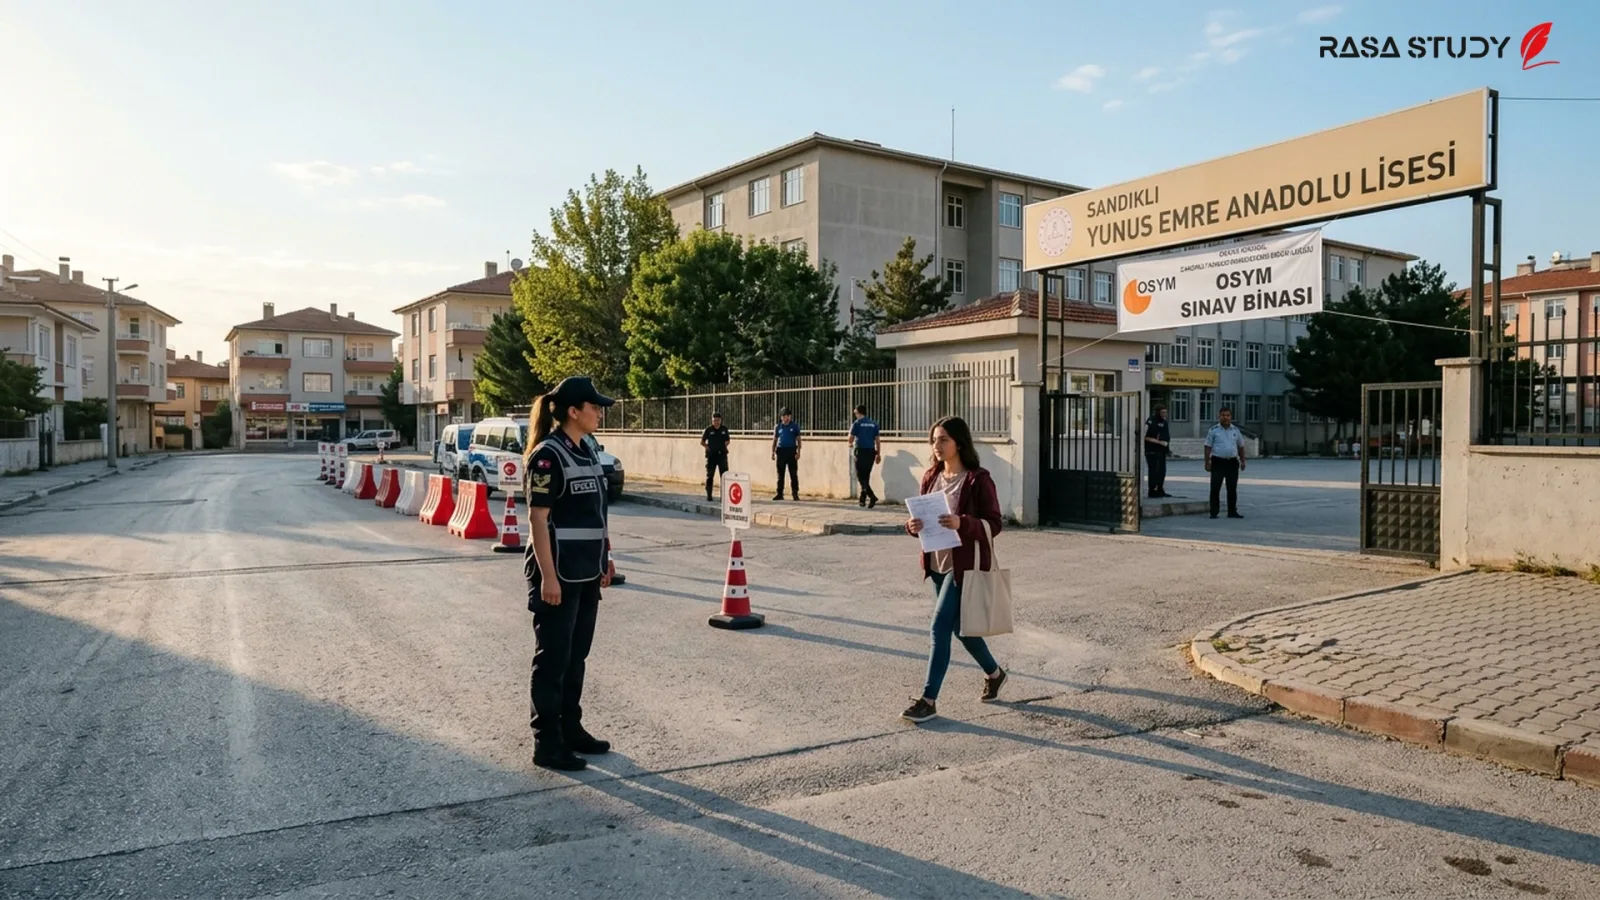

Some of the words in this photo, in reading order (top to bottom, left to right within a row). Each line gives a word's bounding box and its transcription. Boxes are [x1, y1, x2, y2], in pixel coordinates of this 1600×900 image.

[1087, 214, 1153, 247] YUNUS
[1159, 199, 1220, 234] EMRE
[1225, 171, 1351, 222] ANADOLU
[1360, 140, 1456, 195] LİSESİ
[1087, 186, 1159, 218] SANDIKLI
[1137, 276, 1176, 294] OSYM
[1216, 266, 1272, 290] OSYM
[1181, 296, 1237, 318] SINAV
[1243, 286, 1313, 312] BİNASI
